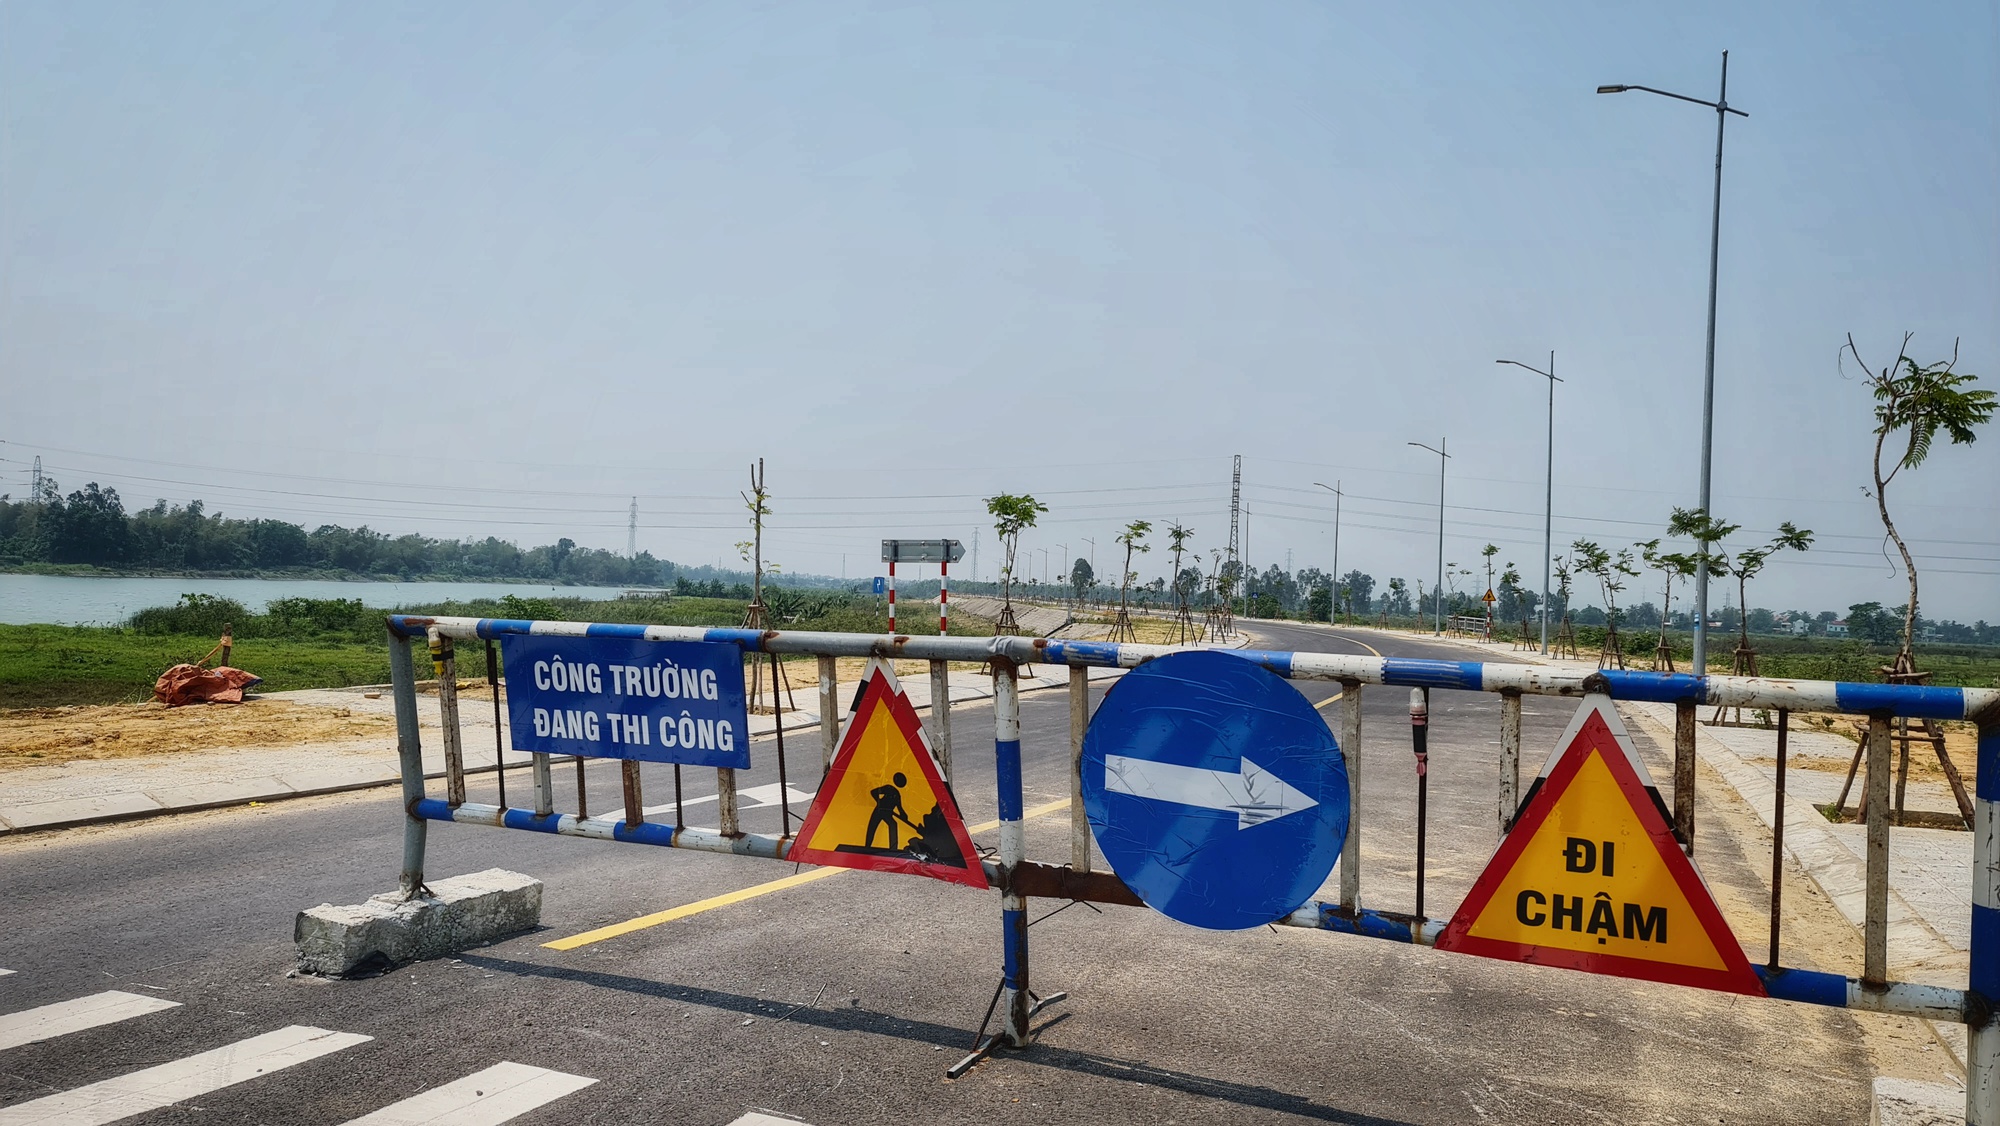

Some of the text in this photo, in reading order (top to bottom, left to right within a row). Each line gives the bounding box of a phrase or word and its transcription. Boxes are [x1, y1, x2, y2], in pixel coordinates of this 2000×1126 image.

[533, 654, 719, 700] CÔNG TRƯỜNG
[533, 707, 734, 751] ĐANG THI CÔNG
[1562, 836, 1615, 877] ĐI
[1515, 889, 1668, 945] CHẬM
